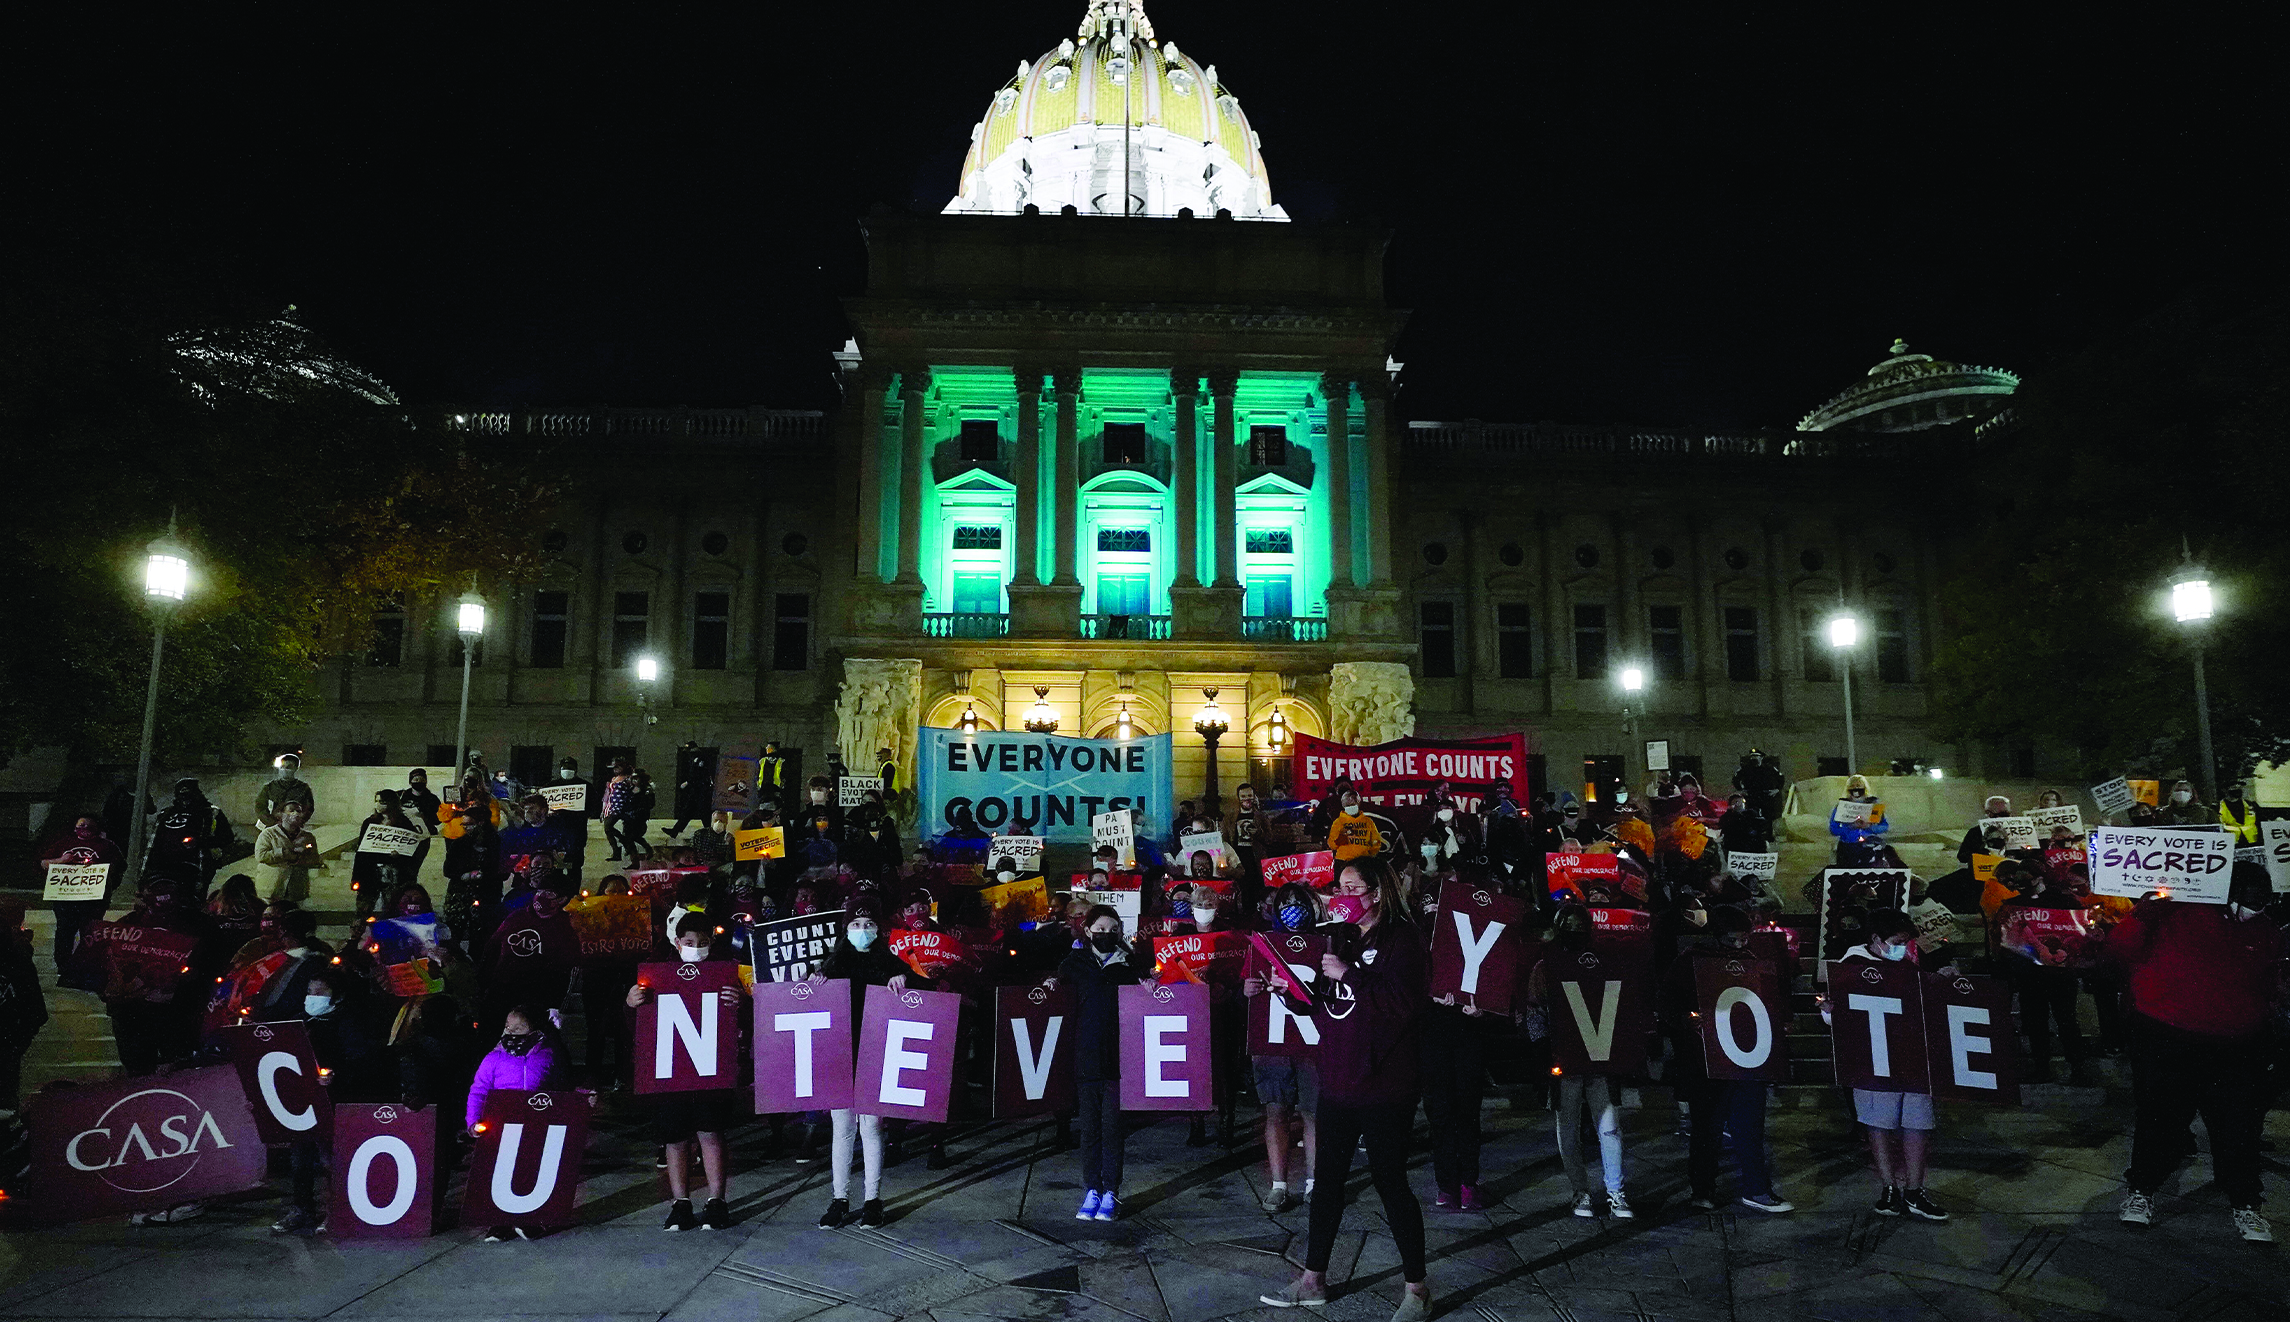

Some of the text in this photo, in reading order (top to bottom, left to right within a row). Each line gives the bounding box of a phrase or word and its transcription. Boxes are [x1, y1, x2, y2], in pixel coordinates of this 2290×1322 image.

[948, 742, 1145, 773] EVERYONE
[1306, 752, 1514, 781] EVERYONE COUNTS
[841, 779, 881, 789] BLACK
[2095, 779, 2124, 795] STOP
[546, 791, 584, 803] ACRED
[841, 797, 864, 805] MAT
[1105, 813, 1118, 824] PA
[366, 832, 418, 845] SACRED
[739, 835, 770, 849] VOTERS
[1014, 838, 1032, 846] VOTE
[1097, 824, 1126, 838] MUST
[2006, 826, 2033, 836] CRED
[2104, 833, 2228, 851] EVERY VOTE IS
[754, 840, 781, 853] DECIDE
[991, 845, 1040, 857] SACRED
[1264, 856, 1298, 881] DEFEND
[1302, 858, 1335, 876] DEMOCRACY!
[1547, 855, 1580, 875] DEFEND
[1583, 864, 1619, 876] DEMOCRACY!
[1730, 860, 1776, 871] SACRED
[2046, 850, 2084, 868] DEFEND
[2102, 847, 2228, 875] SACRED
[49, 874, 105, 887] SACRED
[51, 866, 80, 875] EVERY
[81, 866, 98, 874] VOTE
[633, 872, 670, 894] DEFEND
[1097, 892, 1125, 904] THEM
[766, 921, 836, 946] COUNT
[1917, 912, 1954, 936] ACRED
[83, 925, 143, 948] DEFEND
[507, 933, 543, 955] CASA
[620, 937, 650, 951] VOTO
[889, 933, 940, 957] DEFEND
[768, 936, 837, 965] EVERY
[924, 948, 940, 958] OUR
[1156, 936, 1202, 964] DEFEND
[1190, 944, 1251, 962] OUR DEMOCRACY!
[1452, 910, 1507, 995] Y
[770, 958, 824, 983] VOT
[1561, 980, 1622, 1062] V
[1714, 986, 1773, 1069] O
[655, 991, 719, 1080] N
[1848, 993, 1903, 1078] T
[774, 1011, 831, 1098] T
[1010, 1015, 1064, 1100] V
[1143, 1015, 1190, 1098] E
[1946, 1004, 1998, 1090] E
[878, 1019, 934, 1107] E
[257, 1051, 318, 1132] C
[65, 1110, 234, 1172] CASA
[490, 1123, 567, 1214] U
[347, 1135, 418, 1227] O
